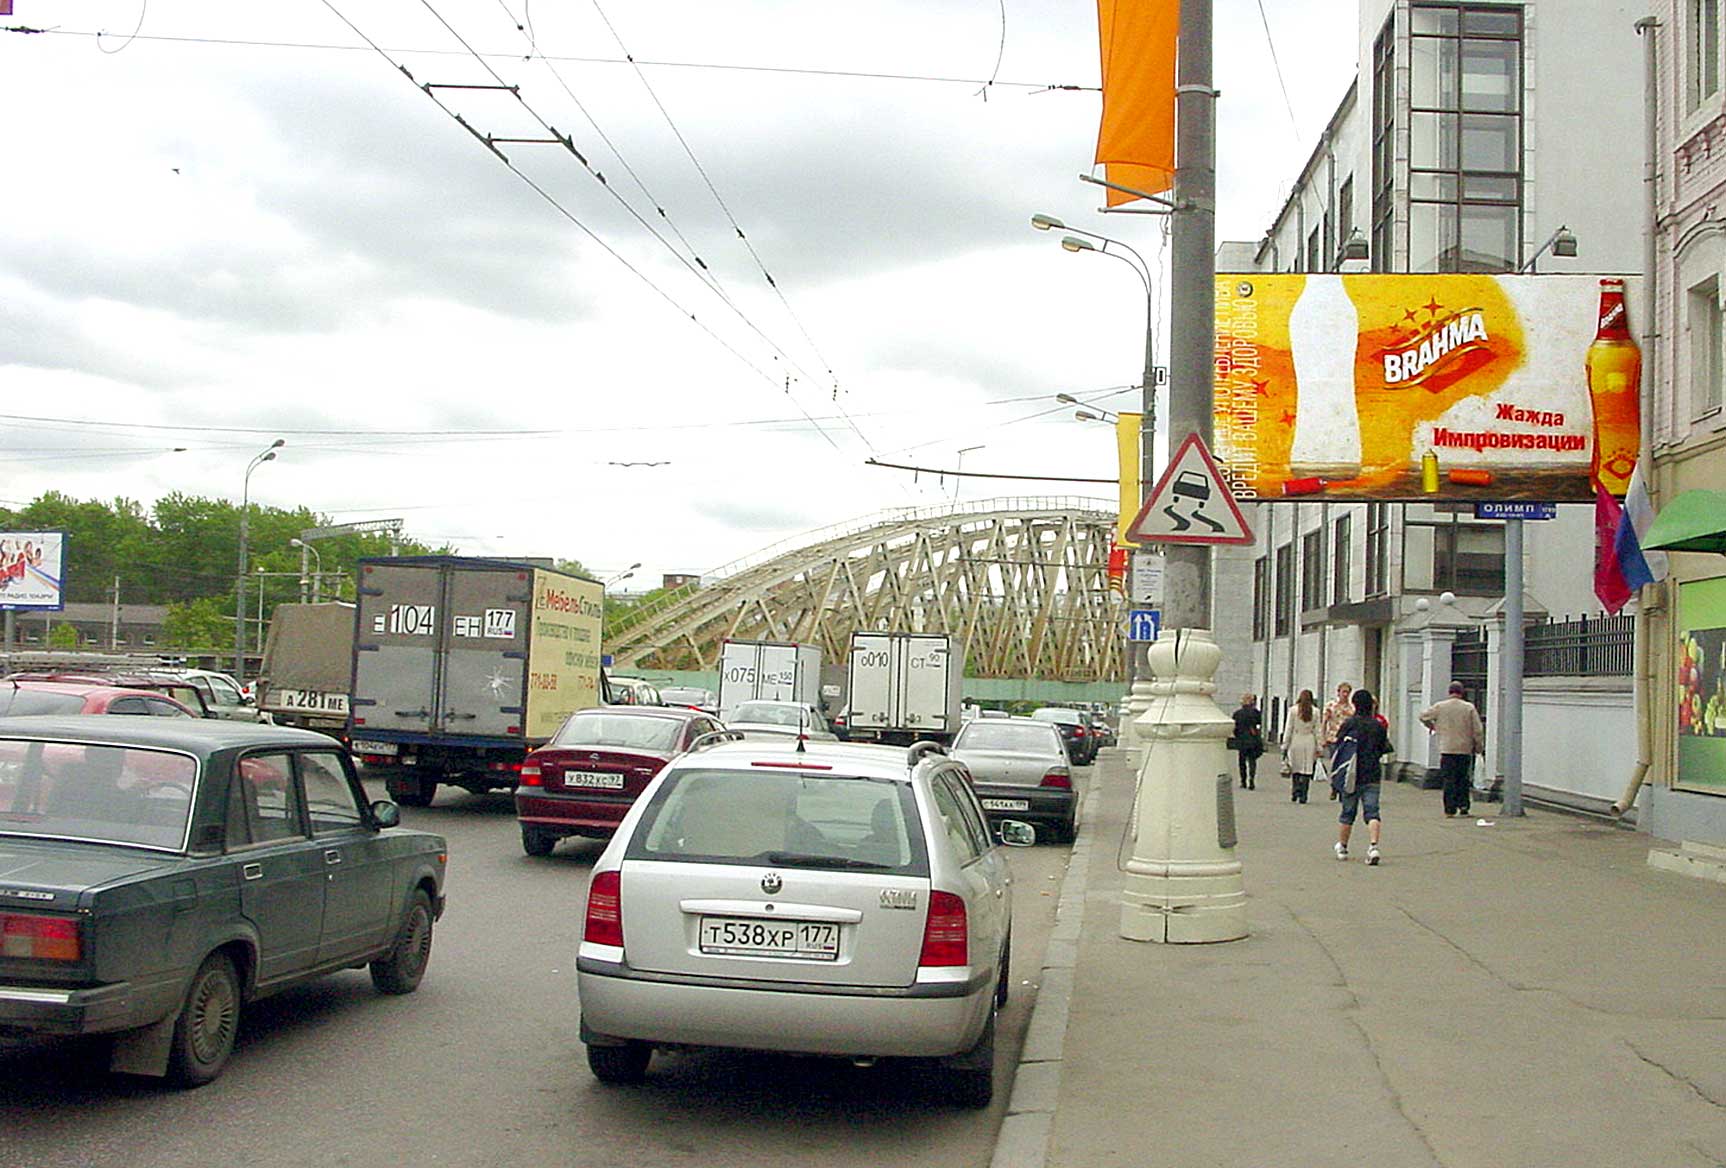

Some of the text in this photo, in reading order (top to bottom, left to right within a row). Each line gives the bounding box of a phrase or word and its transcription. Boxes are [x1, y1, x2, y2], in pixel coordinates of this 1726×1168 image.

[1384, 313, 1488, 383] BRAHMA
[1232, 299, 1261, 499] ВРЕДИТ ВАШЕМУ ЗДОРОВЬЮ
[1496, 403, 1564, 427] Жажда
[1433, 428, 1585, 452] Импровизации
[488, 611, 513, 627] 177
[801, 926, 832, 943] 177
